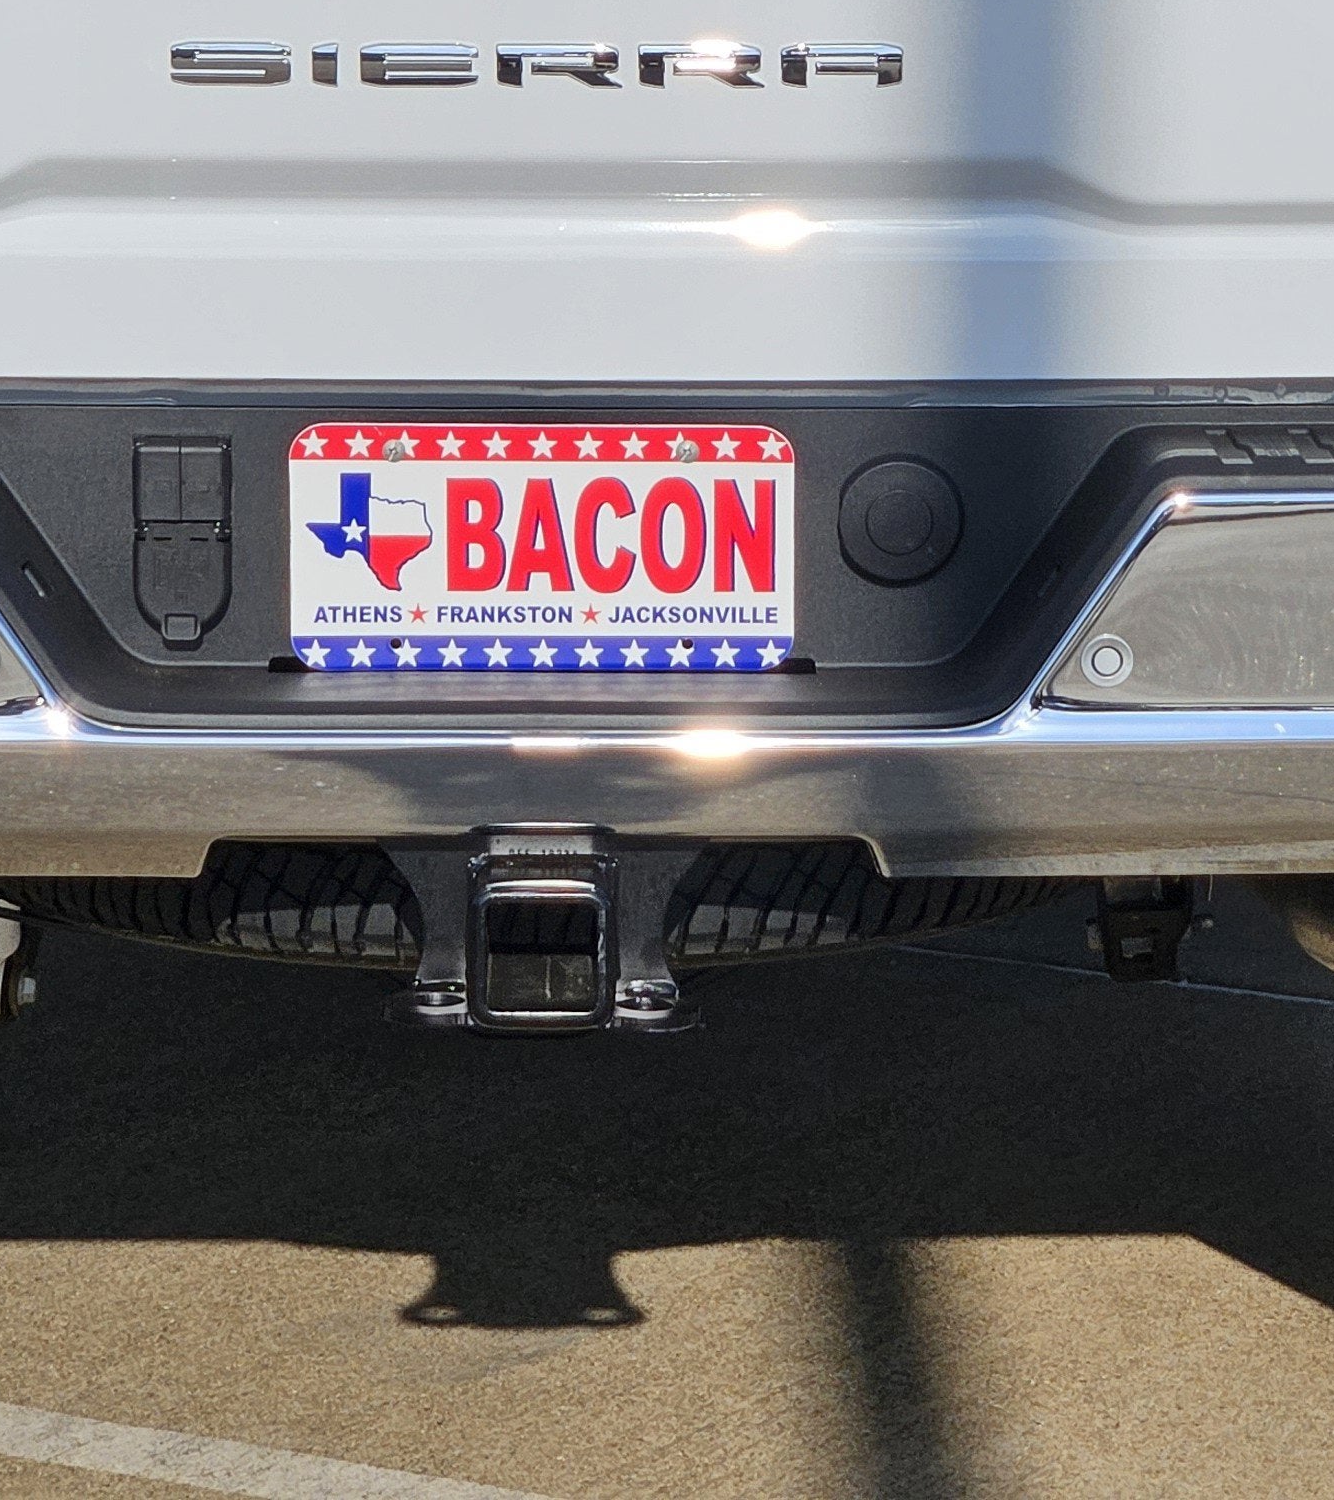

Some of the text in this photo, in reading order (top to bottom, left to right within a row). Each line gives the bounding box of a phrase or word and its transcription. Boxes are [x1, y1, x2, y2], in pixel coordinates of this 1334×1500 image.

[170, 42, 904, 88] SIERRA
[446, 476, 776, 594] BACON
[313, 605, 779, 624] ATHENS FRANKSTON JACKSONVILLE
